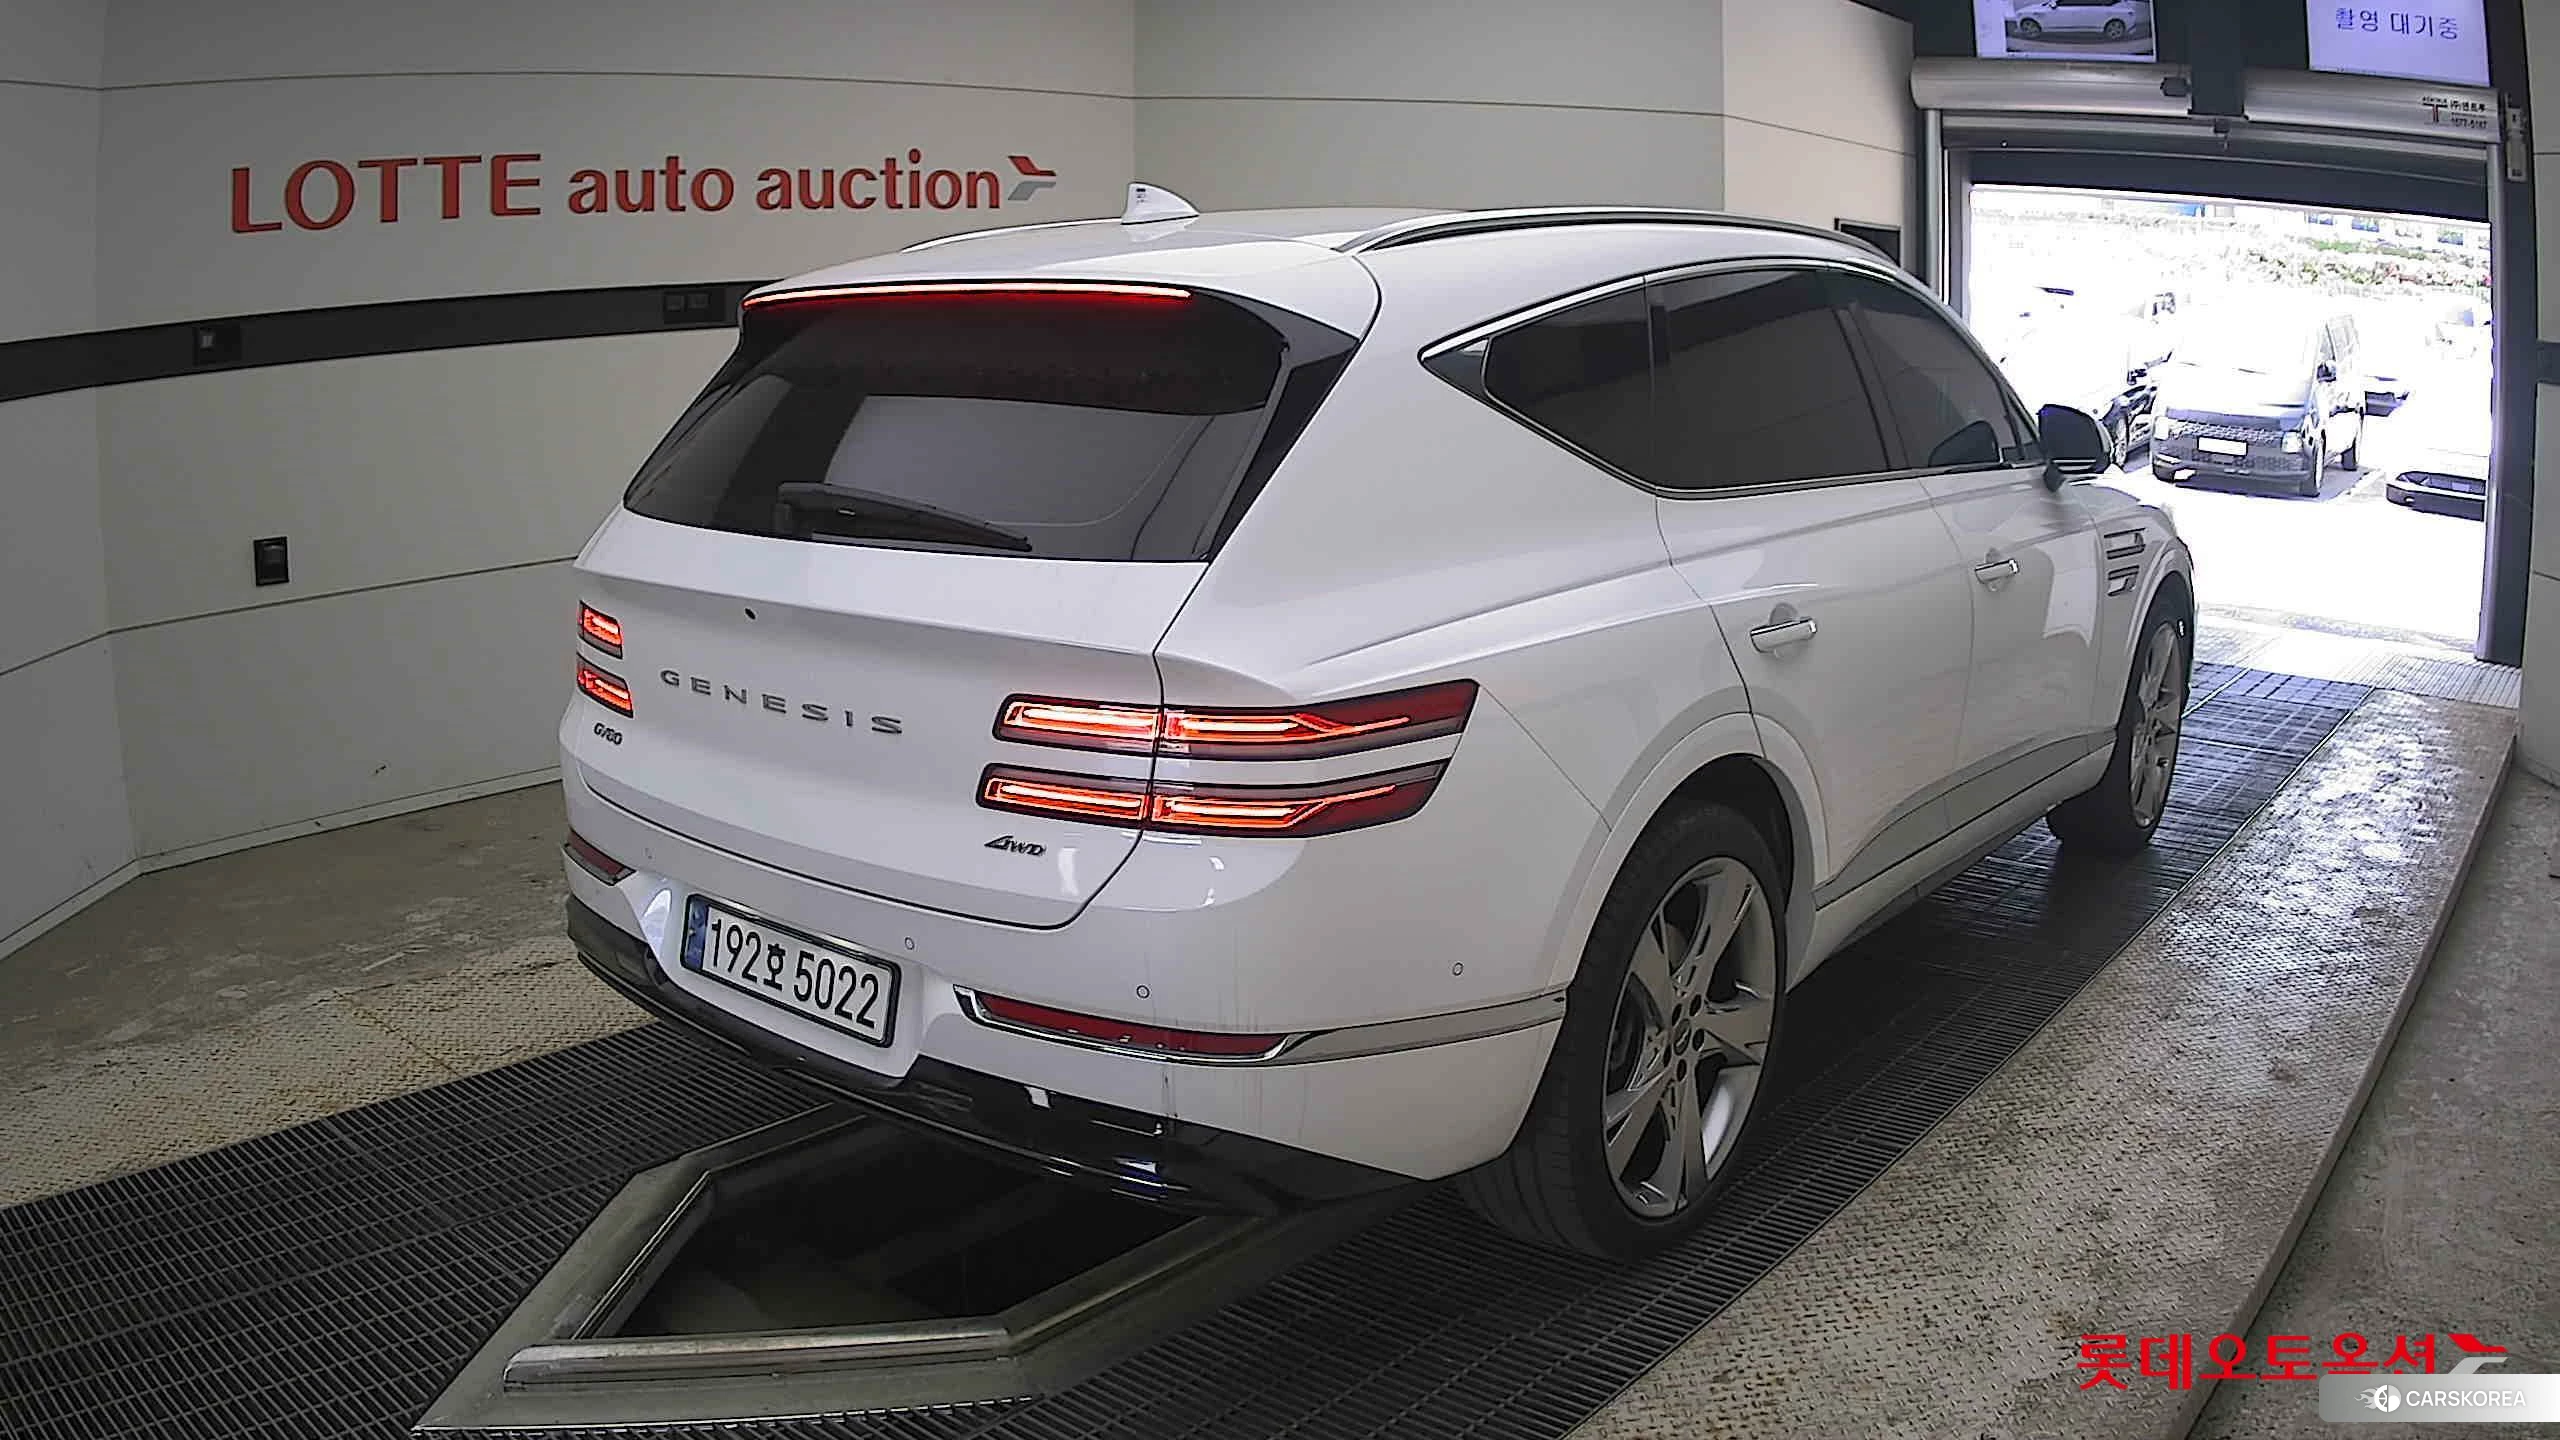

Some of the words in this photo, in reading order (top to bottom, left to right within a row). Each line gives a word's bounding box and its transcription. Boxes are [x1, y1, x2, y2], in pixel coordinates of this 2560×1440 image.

[2390, 13, 2458, 40] 대기중
[231, 152, 541, 234] LOTTE
[567, 154, 735, 214] auto
[756, 148, 1001, 210] auction
[659, 669, 903, 736] GENESIS
[711, 918, 786, 992] 192호
[793, 949, 880, 1029] 5022
